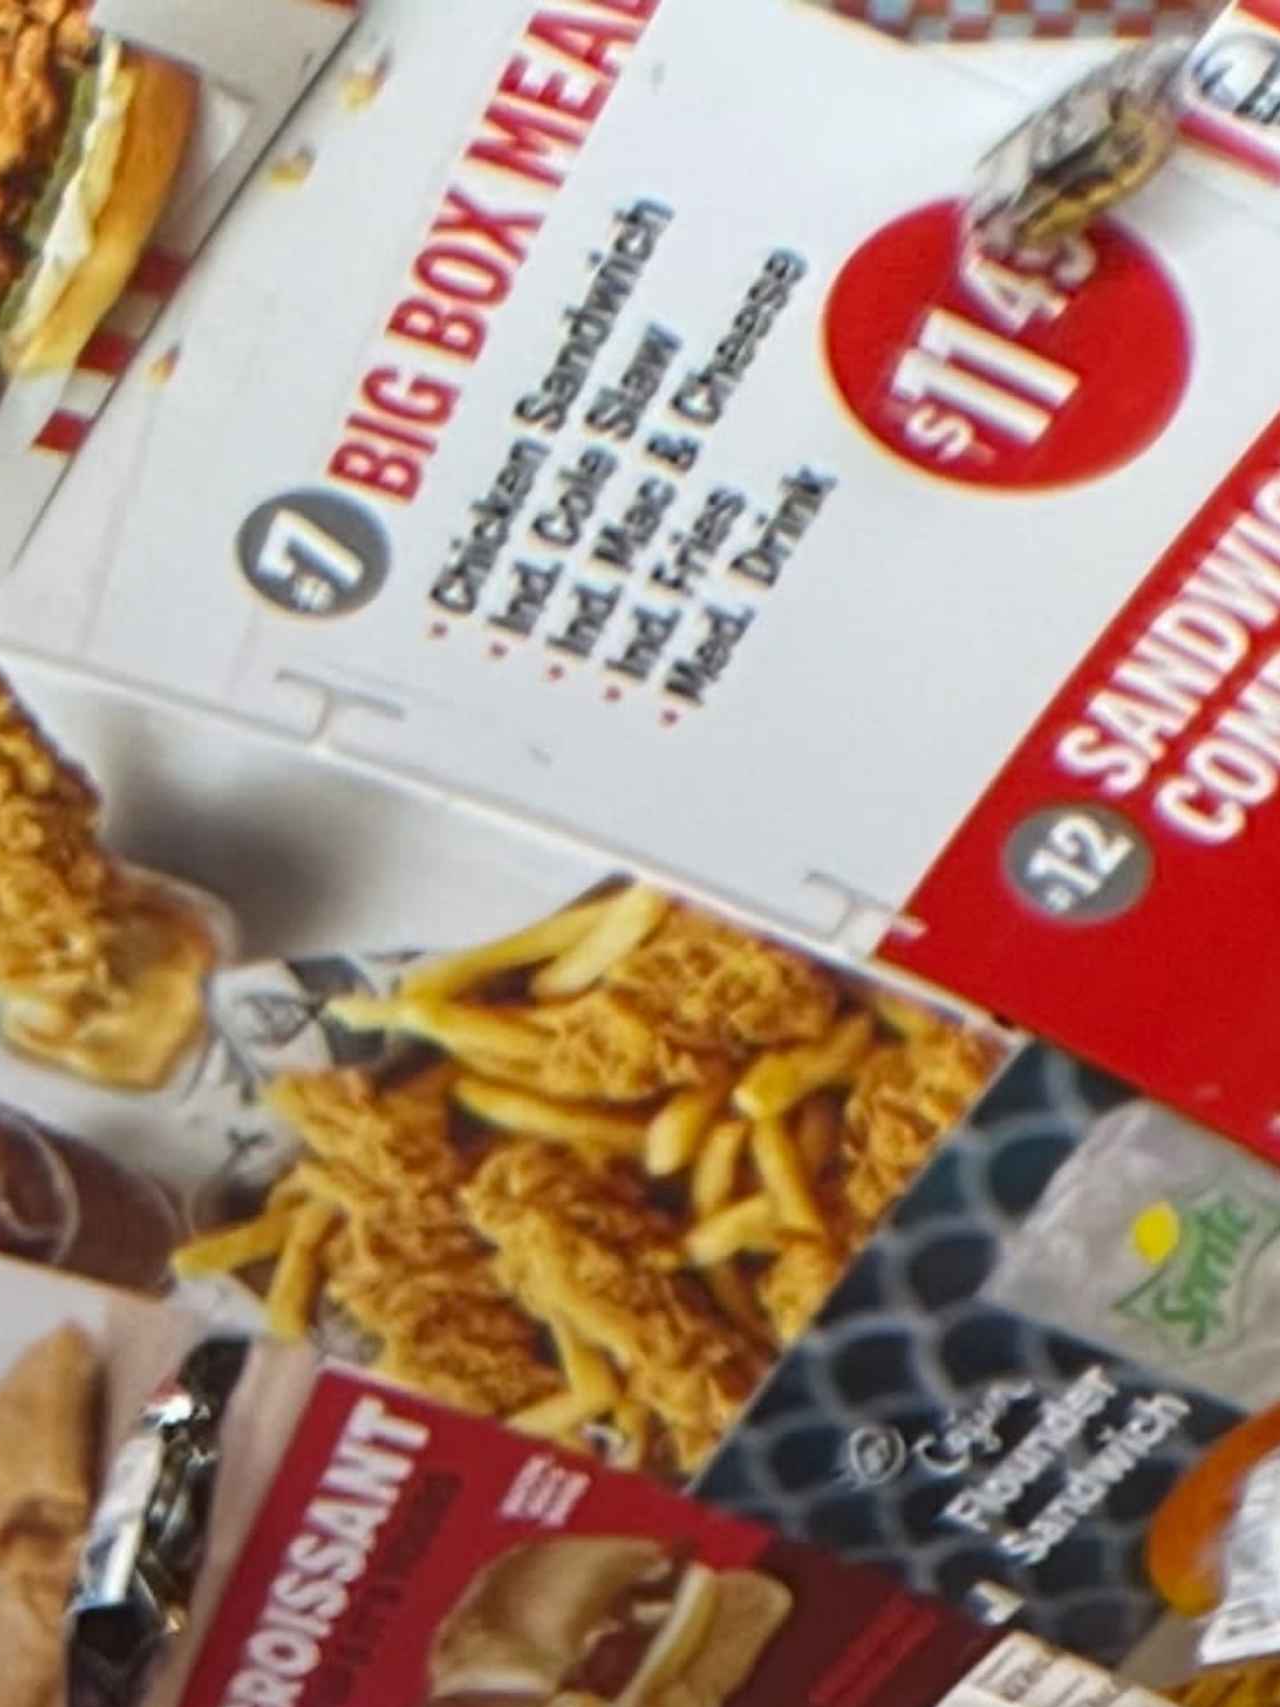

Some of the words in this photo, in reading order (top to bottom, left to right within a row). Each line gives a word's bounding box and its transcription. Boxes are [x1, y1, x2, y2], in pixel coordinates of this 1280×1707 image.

[385, 187, 547, 364] BOX
[672, 238, 808, 429] Cheese
[327, 367, 461, 505] BIG
[429, 431, 550, 620] Chicken
[517, 191, 674, 438] Sandwich
[489, 550, 563, 641] Ind.
[535, 439, 617, 552] Cole
[588, 316, 684, 445] Slaw
[645, 422, 701, 475] &
[597, 469, 675, 572] Mac
[656, 480, 747, 599] Fries
[664, 594, 753, 710] Med.
[733, 459, 839, 589] Drink
[547, 568, 623, 662] Ind.
[944, 1364, 1117, 1533] Flounder
[998, 1390, 1193, 1566] Sandwich
